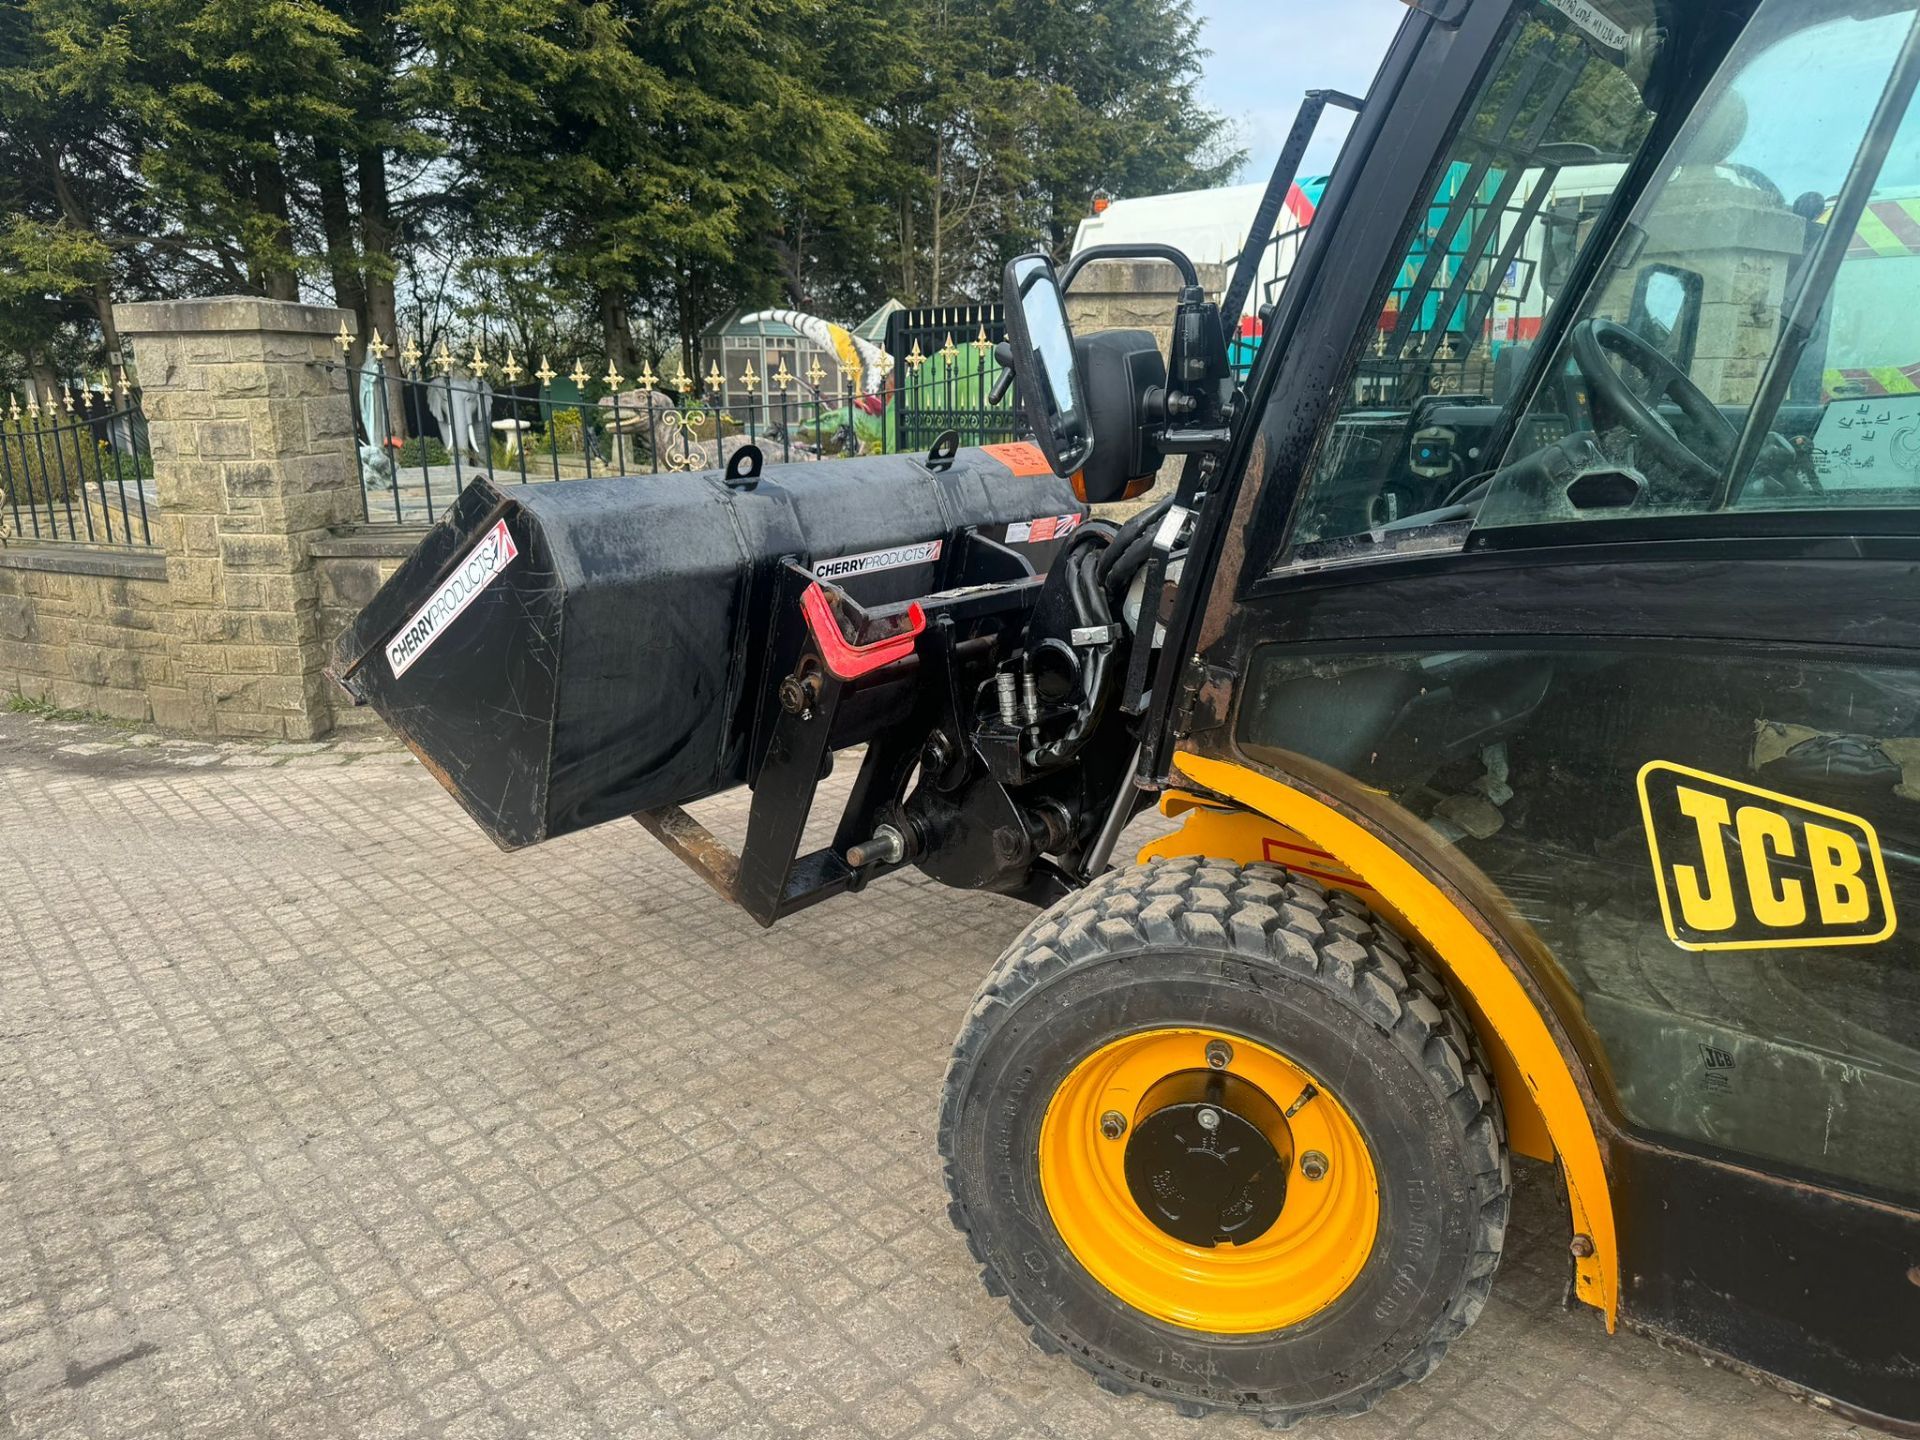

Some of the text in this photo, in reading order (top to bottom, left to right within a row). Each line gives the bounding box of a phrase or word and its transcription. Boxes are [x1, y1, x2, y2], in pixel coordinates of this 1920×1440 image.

[816, 546, 926, 578] CHERRYPRODUCTS
[391, 547, 494, 667] CHERRYPRODUCTS
[1673, 785, 1870, 931] JCB
[1706, 1047, 1733, 1067] JCB
